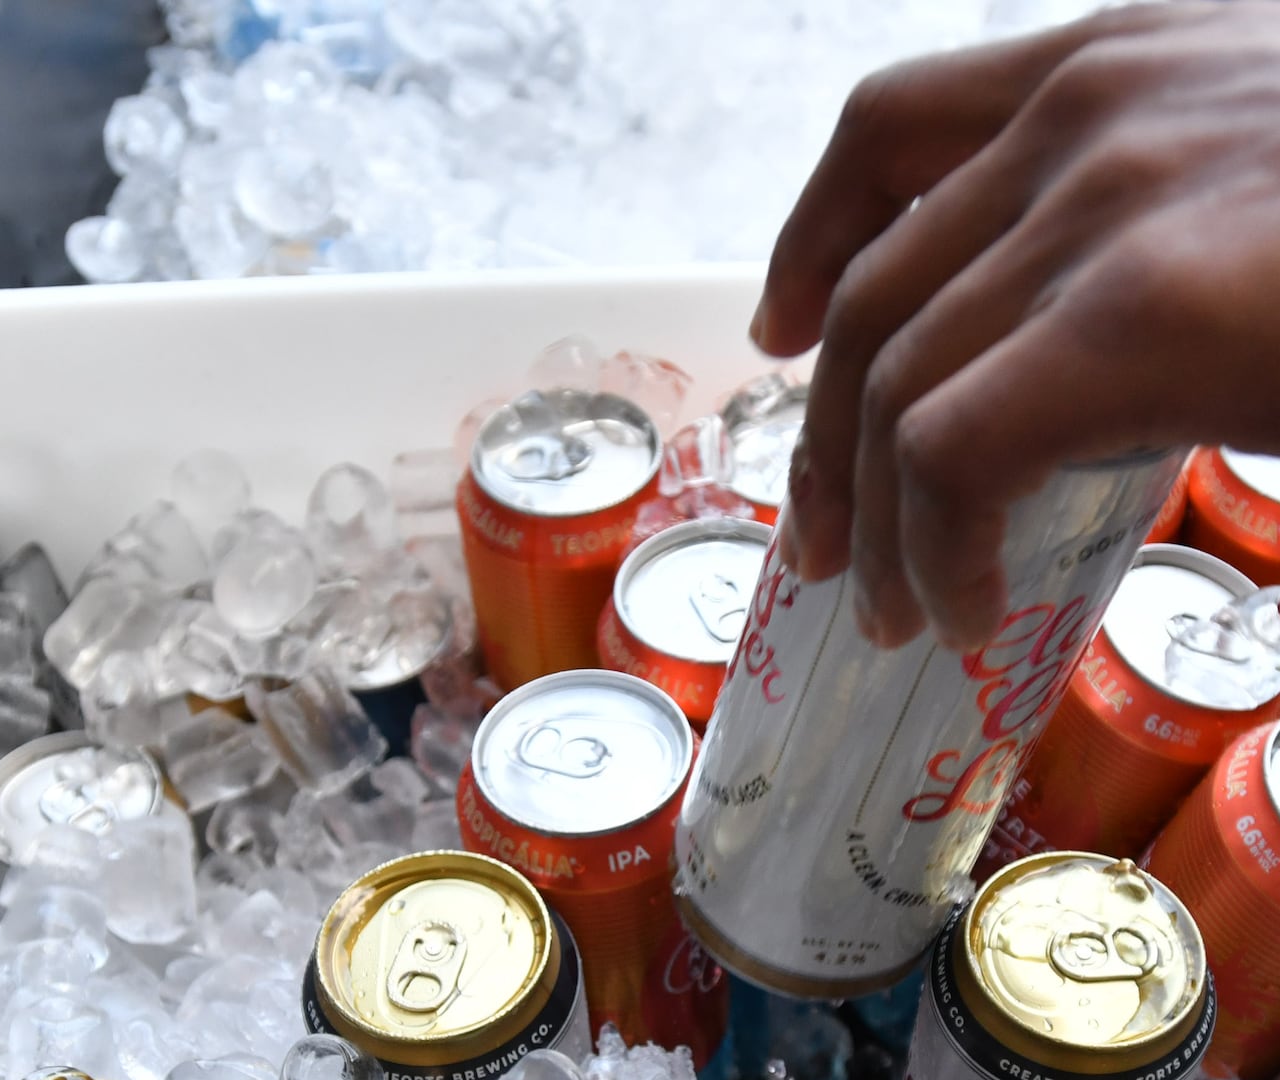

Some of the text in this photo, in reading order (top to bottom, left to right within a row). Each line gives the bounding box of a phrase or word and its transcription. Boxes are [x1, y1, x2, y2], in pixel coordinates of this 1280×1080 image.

[608, 844, 652, 873] IPA
[529, 1022, 555, 1045] CO.
[949, 1006, 966, 1034] CO.
[1182, 994, 1216, 1061] BREWING
